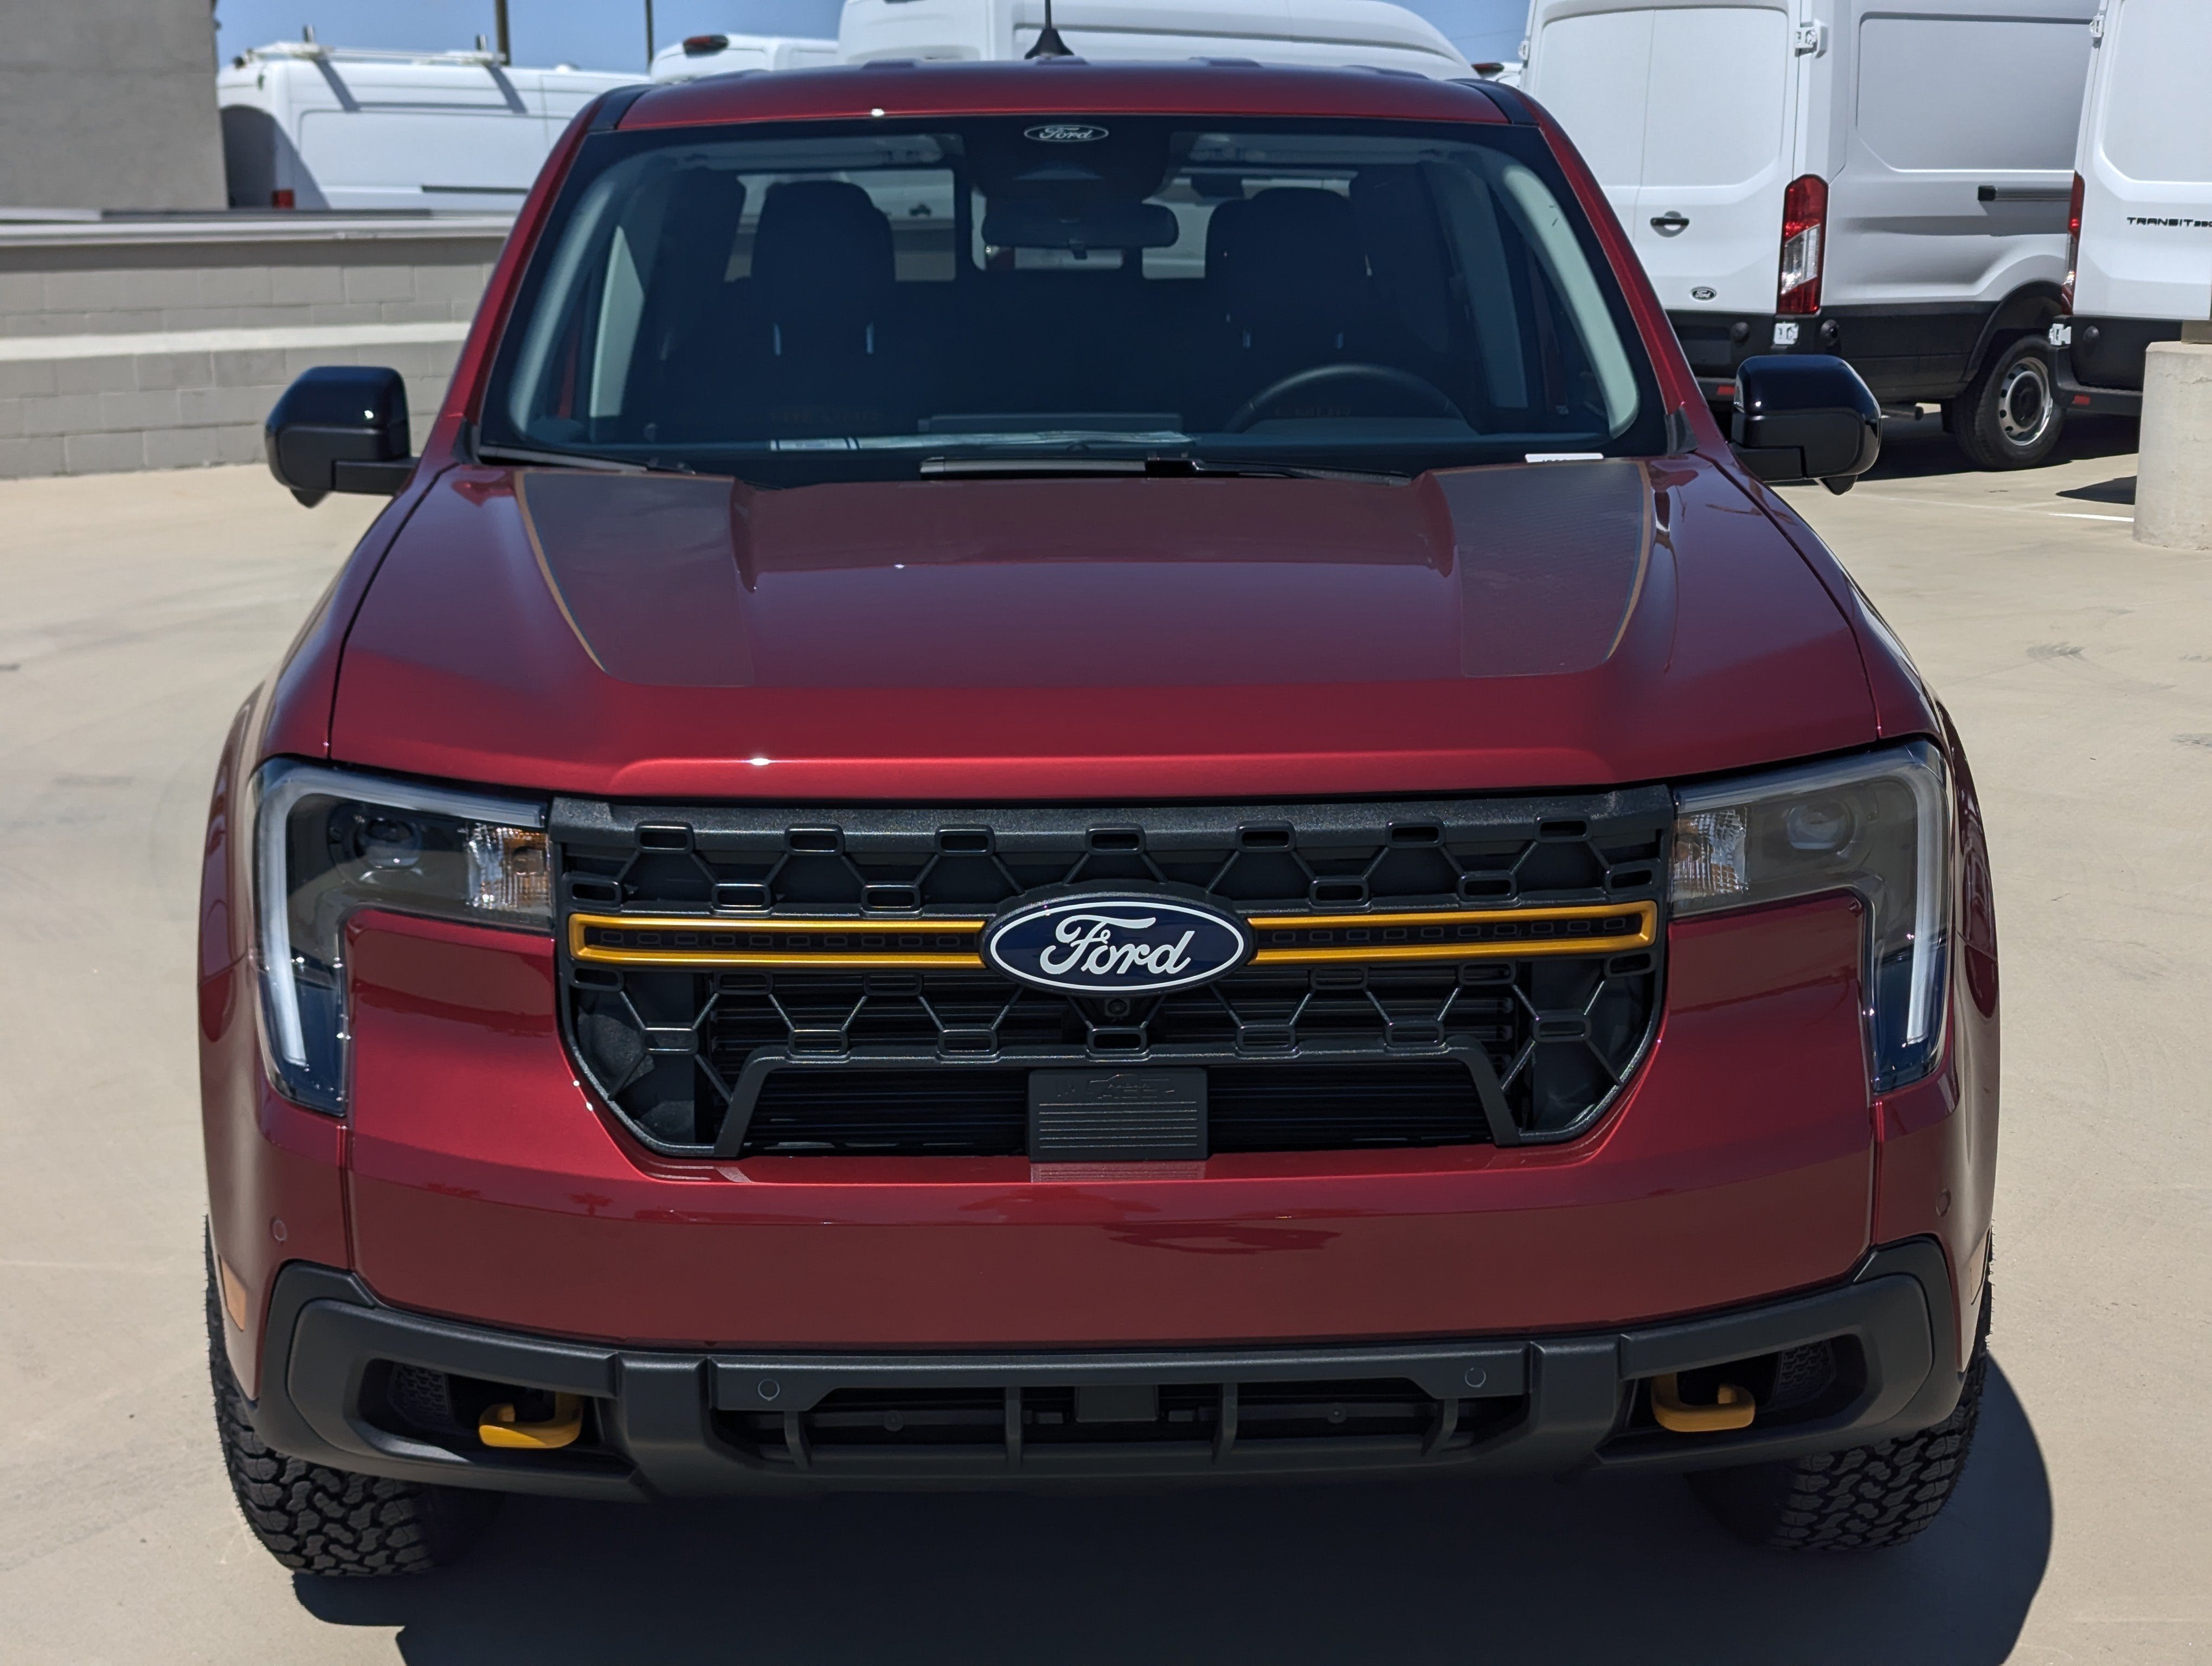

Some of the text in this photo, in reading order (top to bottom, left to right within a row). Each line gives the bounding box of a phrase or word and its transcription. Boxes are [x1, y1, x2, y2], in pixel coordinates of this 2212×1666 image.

[1039, 127, 1093, 138] Ford
[2126, 217, 2194, 227] TRANSIT
[1040, 914, 1195, 975] Ford
